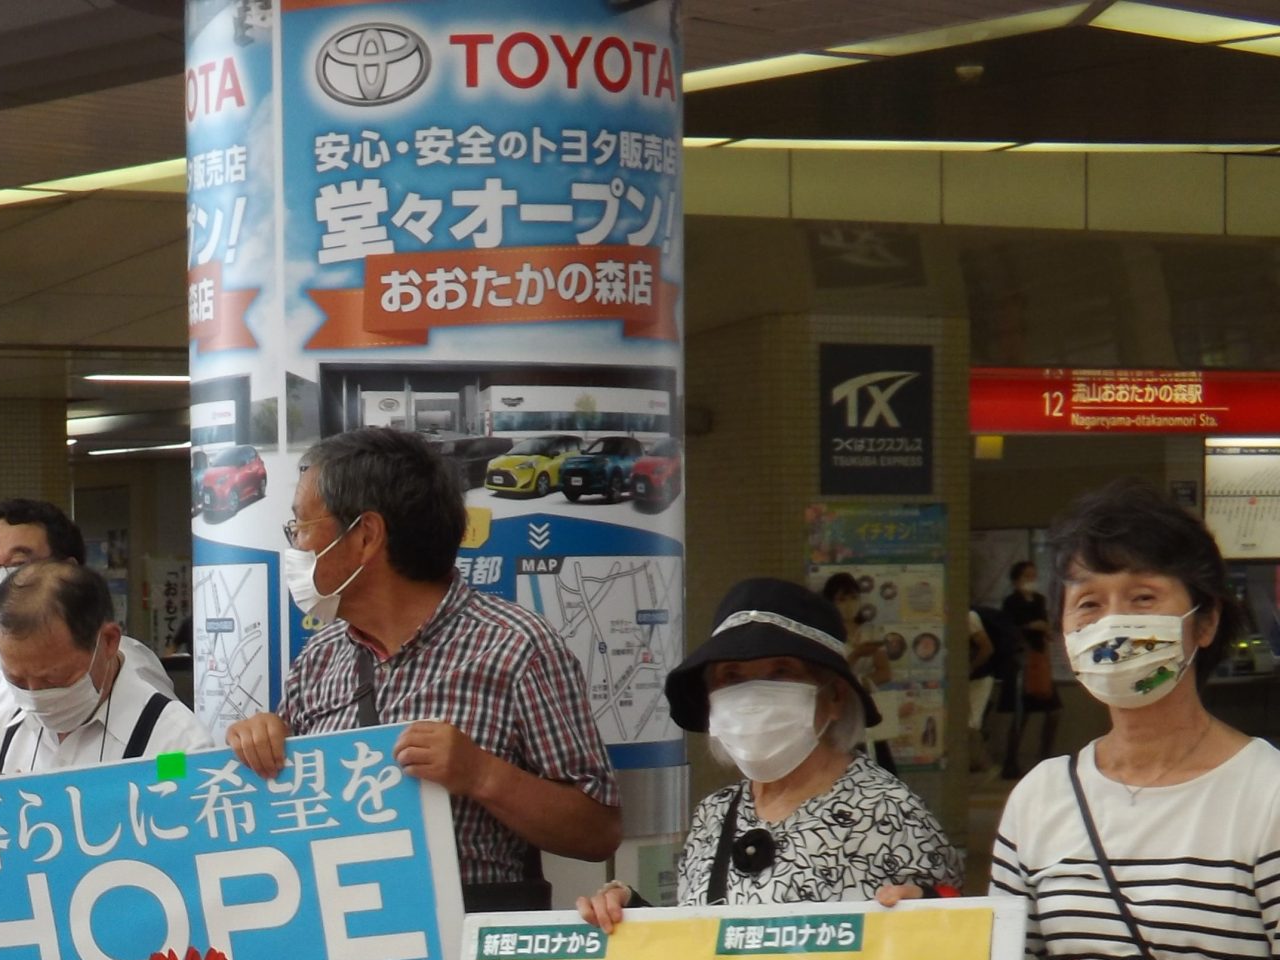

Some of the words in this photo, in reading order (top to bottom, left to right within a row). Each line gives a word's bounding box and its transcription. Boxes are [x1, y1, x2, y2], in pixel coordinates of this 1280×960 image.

[450, 31, 677, 102] TOYOTA
[379, 260, 654, 313] おおたかの森店
[832, 371, 920, 428] TX
[1042, 391, 1065, 417] 12
[522, 558, 558, 572] MAP
[482, 931, 601, 956] 新型コロナから
[724, 921, 856, 951] 新型コロナから
